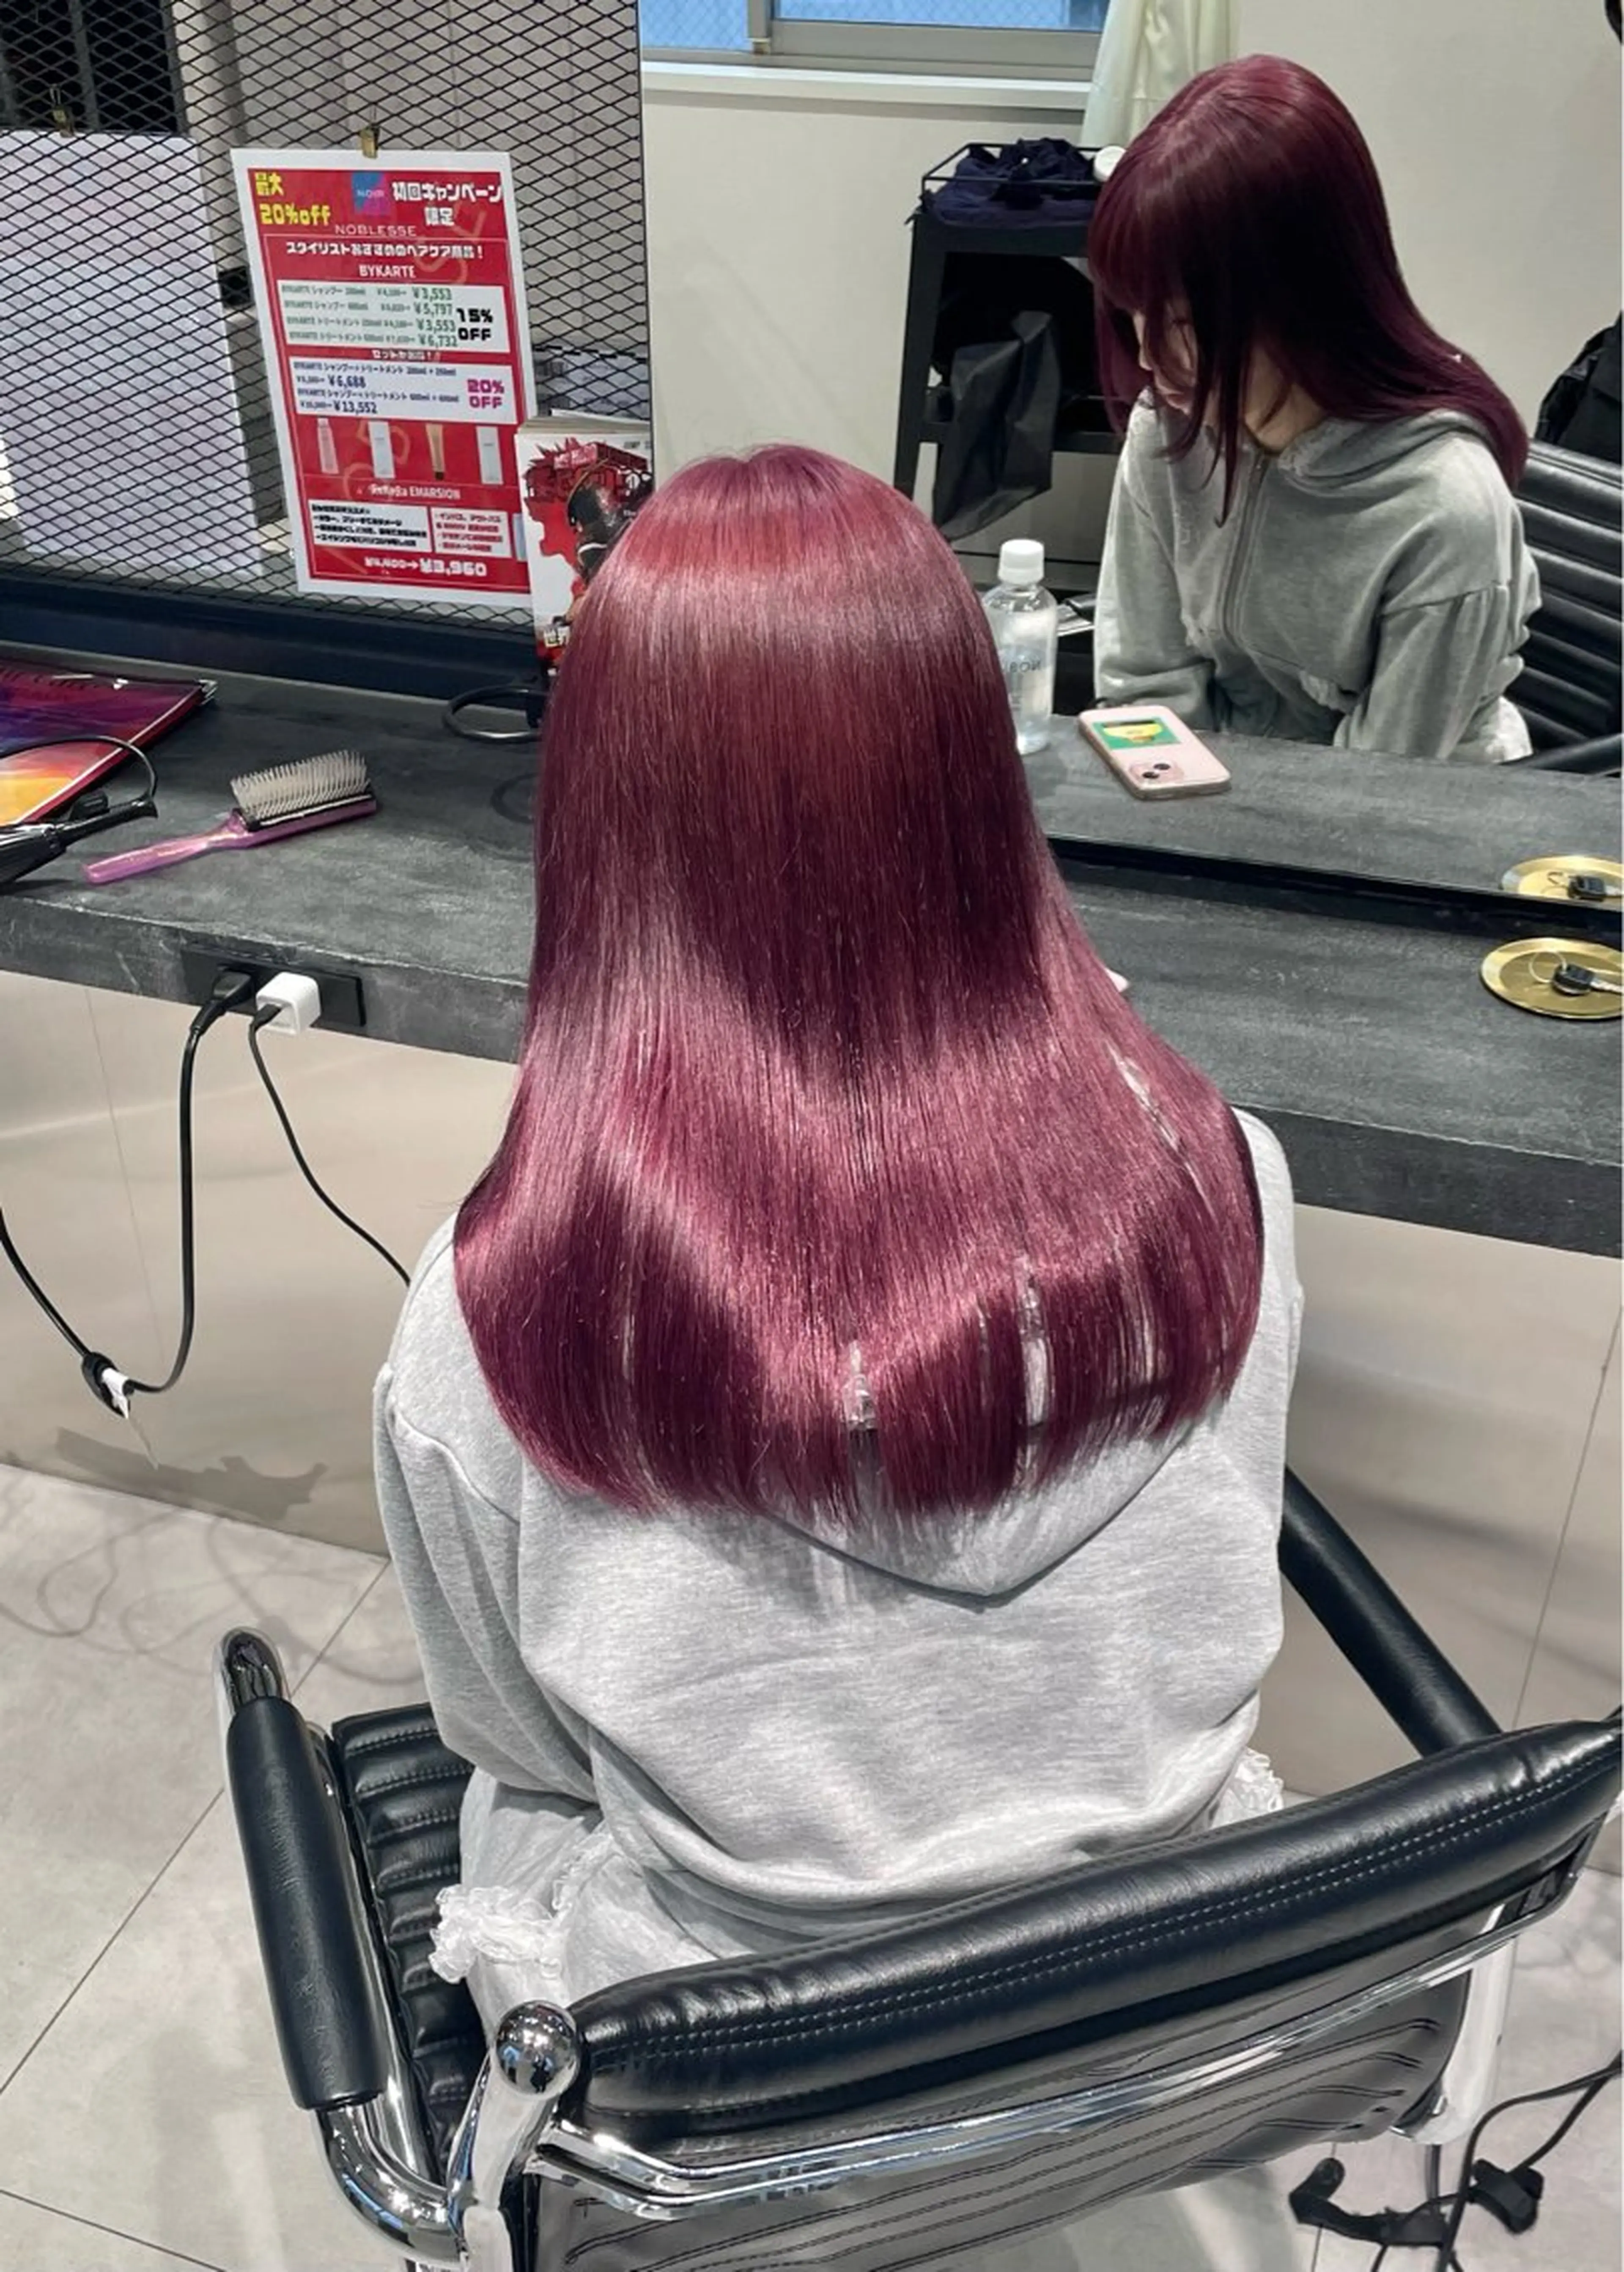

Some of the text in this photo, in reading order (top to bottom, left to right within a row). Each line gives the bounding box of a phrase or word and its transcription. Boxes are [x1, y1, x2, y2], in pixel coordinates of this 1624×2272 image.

[259, 201, 331, 226] 20%off
[335, 224, 417, 236] NOBLESSE
[359, 264, 416, 278] BYKARTE
[456, 307, 493, 323] 15%
[458, 327, 491, 341] OFF
[467, 379, 505, 394] 20%
[333, 401, 377, 415] ¥13,552
[469, 395, 503, 409] OFF
